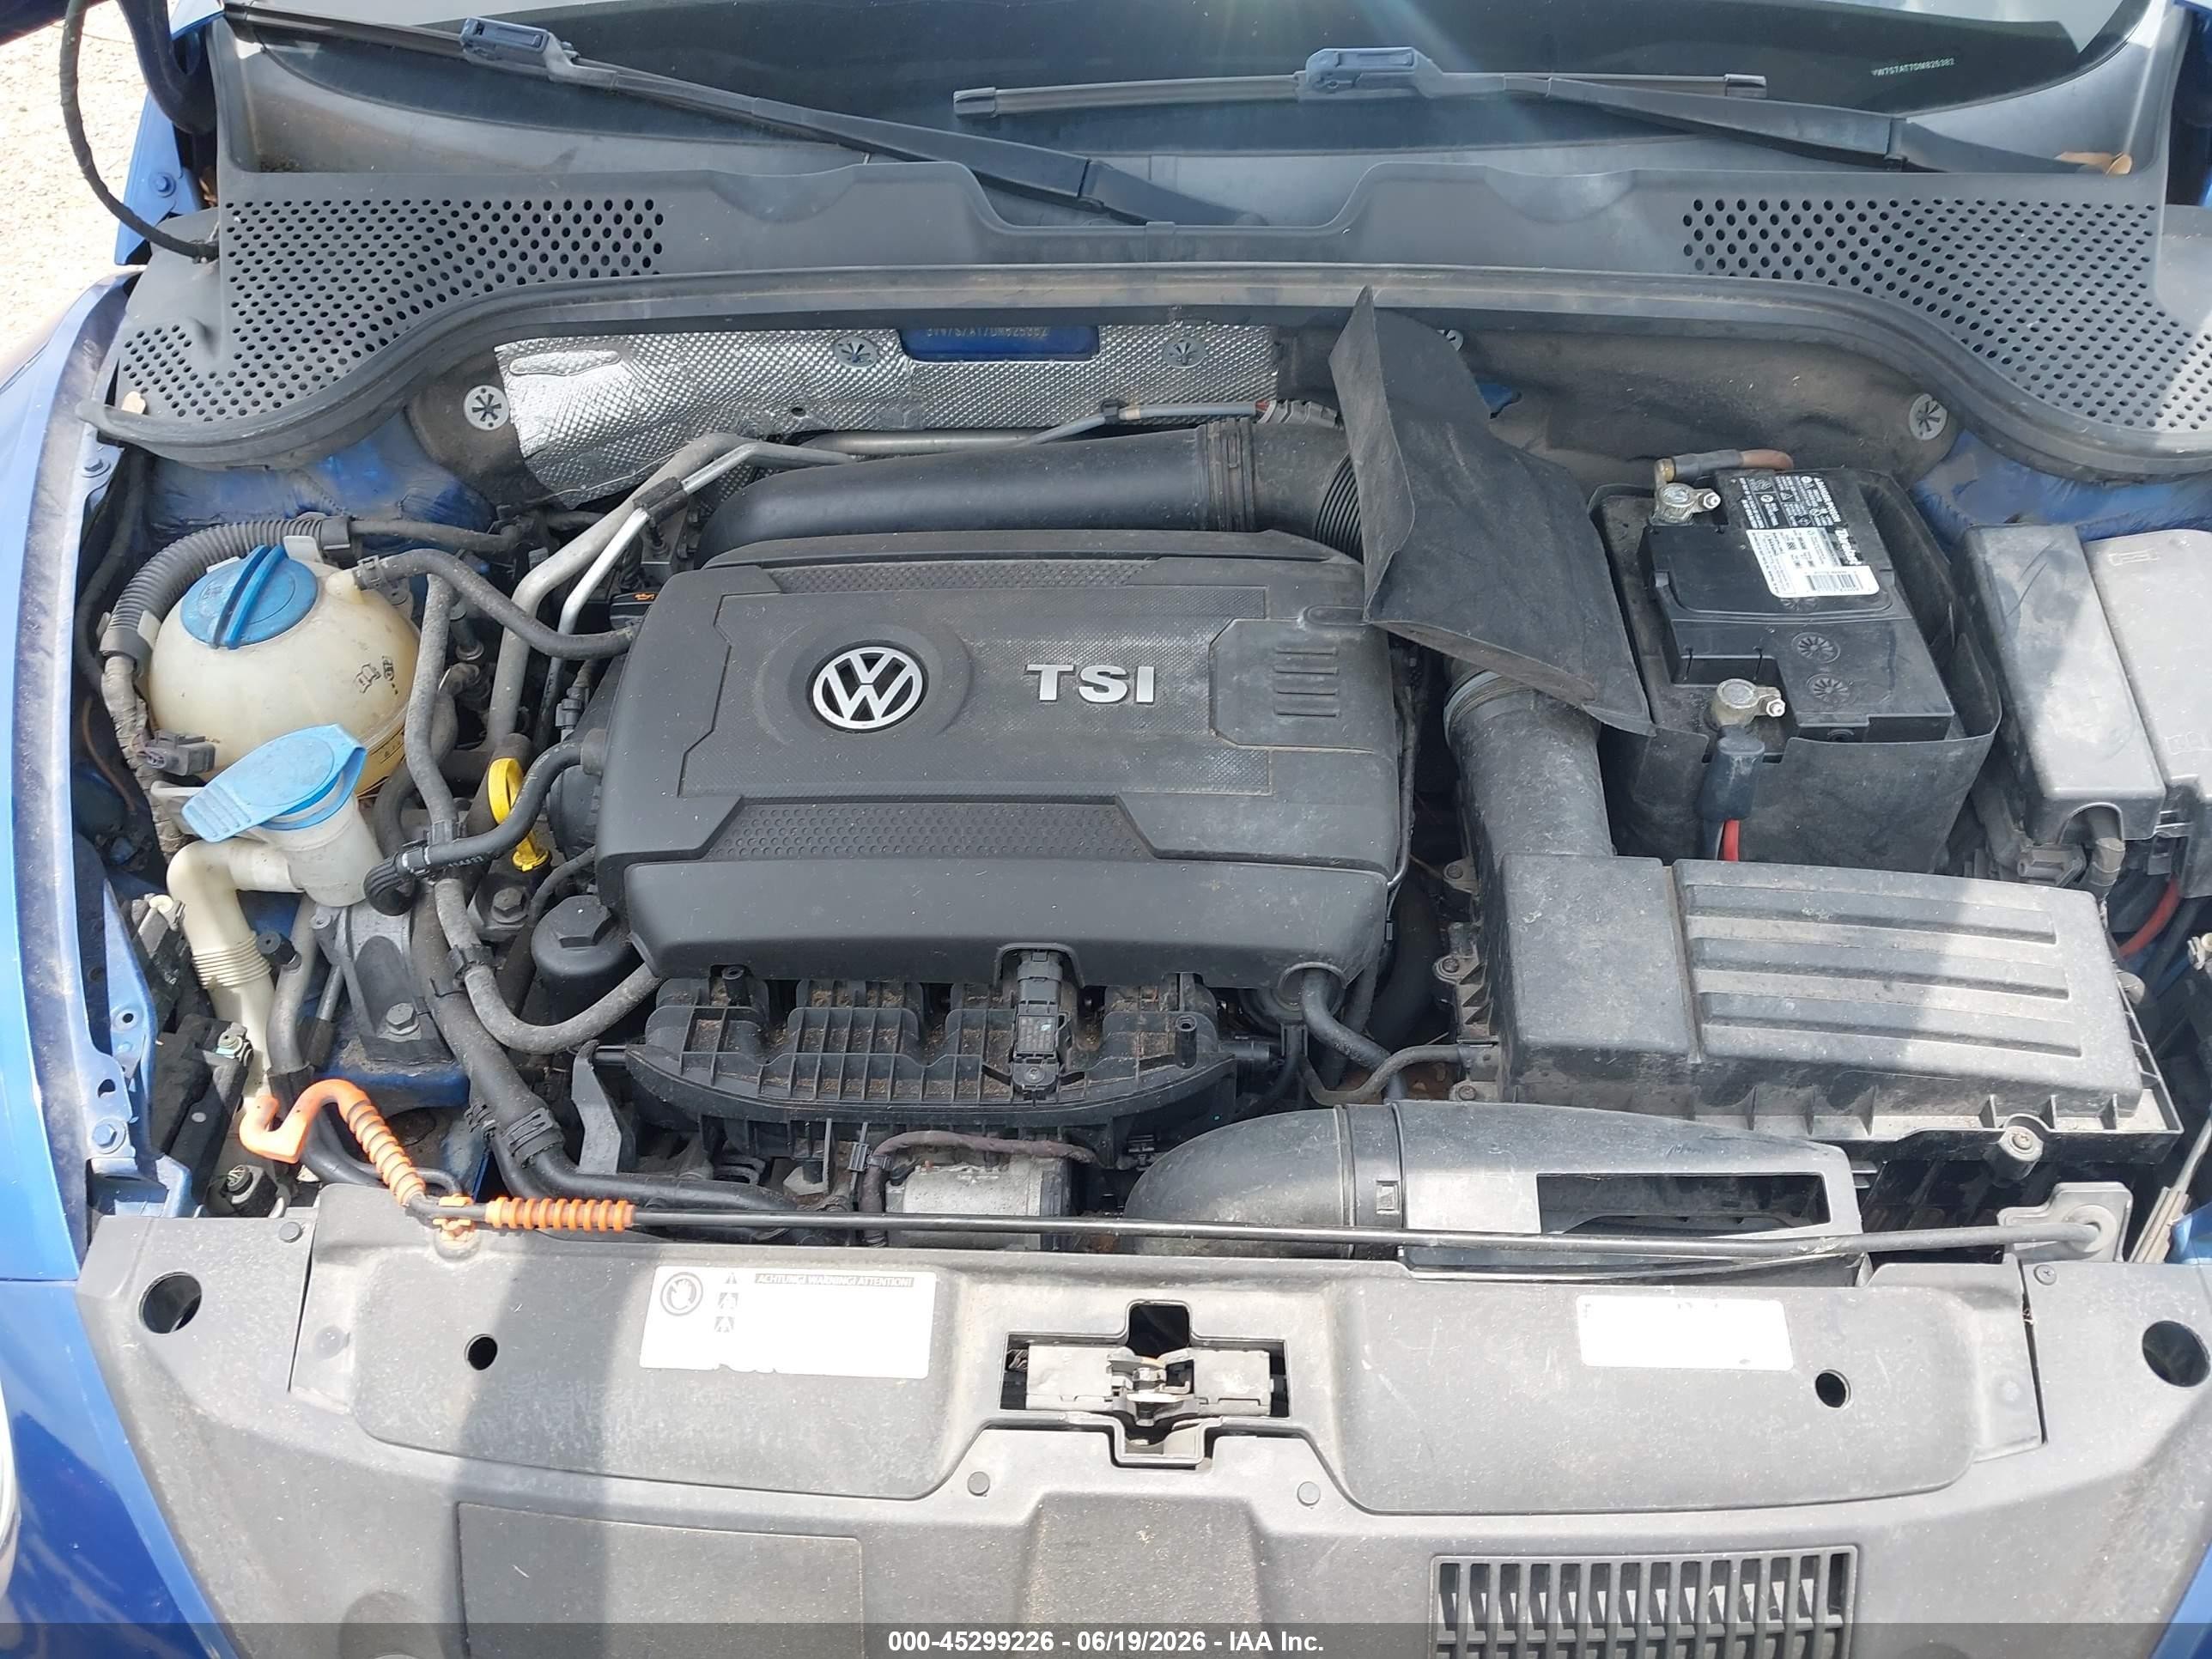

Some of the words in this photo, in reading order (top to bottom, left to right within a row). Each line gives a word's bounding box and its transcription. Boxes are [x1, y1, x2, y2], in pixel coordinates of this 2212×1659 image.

[1026, 663, 1155, 704] TSI
[808, 1275, 857, 1286] WARNING!
[857, 1276, 913, 1287] ATTENTION!
